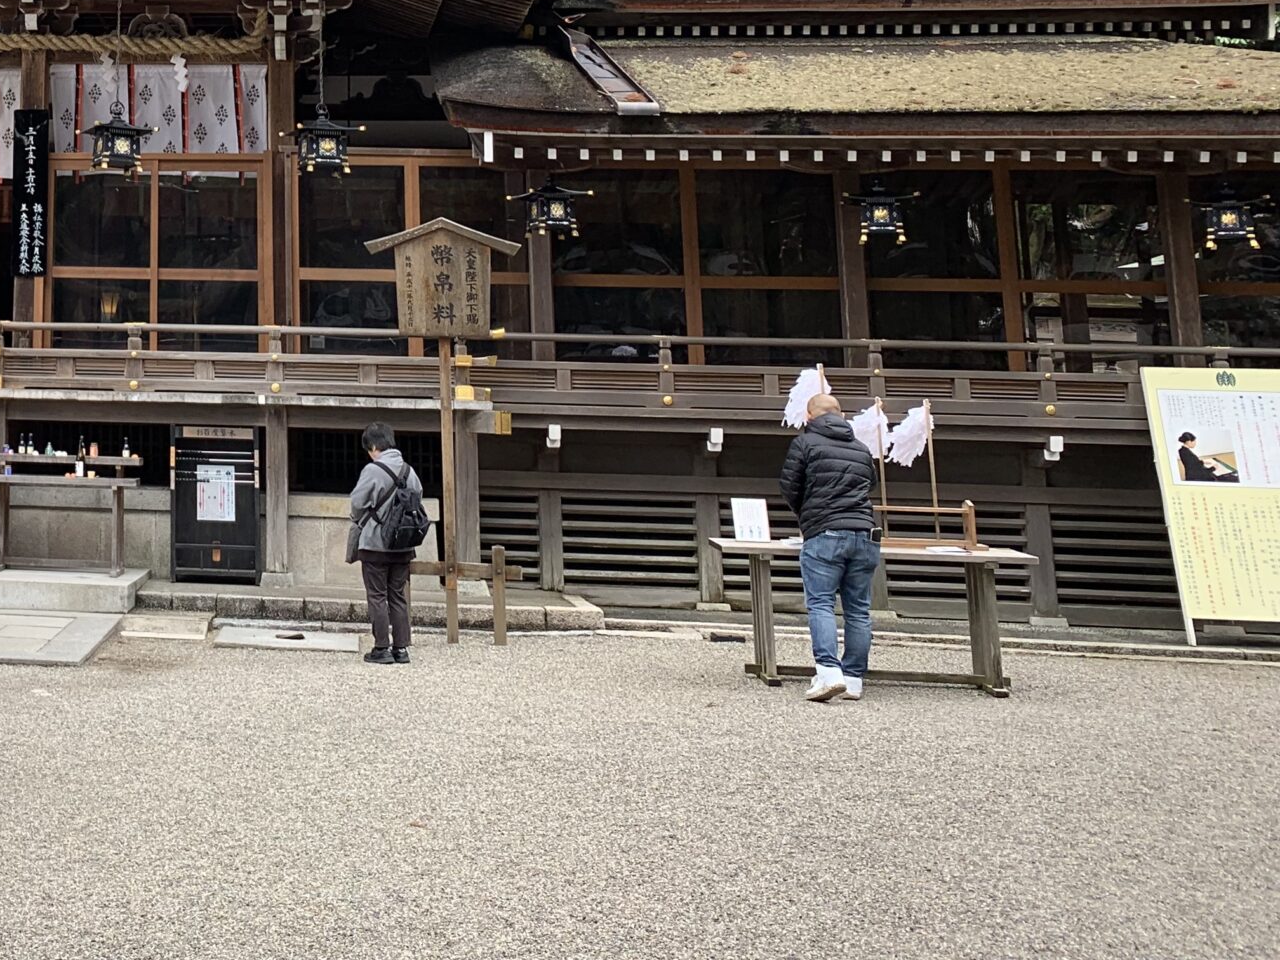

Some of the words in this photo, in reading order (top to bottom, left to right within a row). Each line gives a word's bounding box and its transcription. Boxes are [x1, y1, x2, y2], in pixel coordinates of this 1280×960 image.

[24, 126, 37, 164] 三月十五日
[430, 244, 457, 327] 幣帛料
[465, 248, 479, 326] 天皇陛下御下賜
